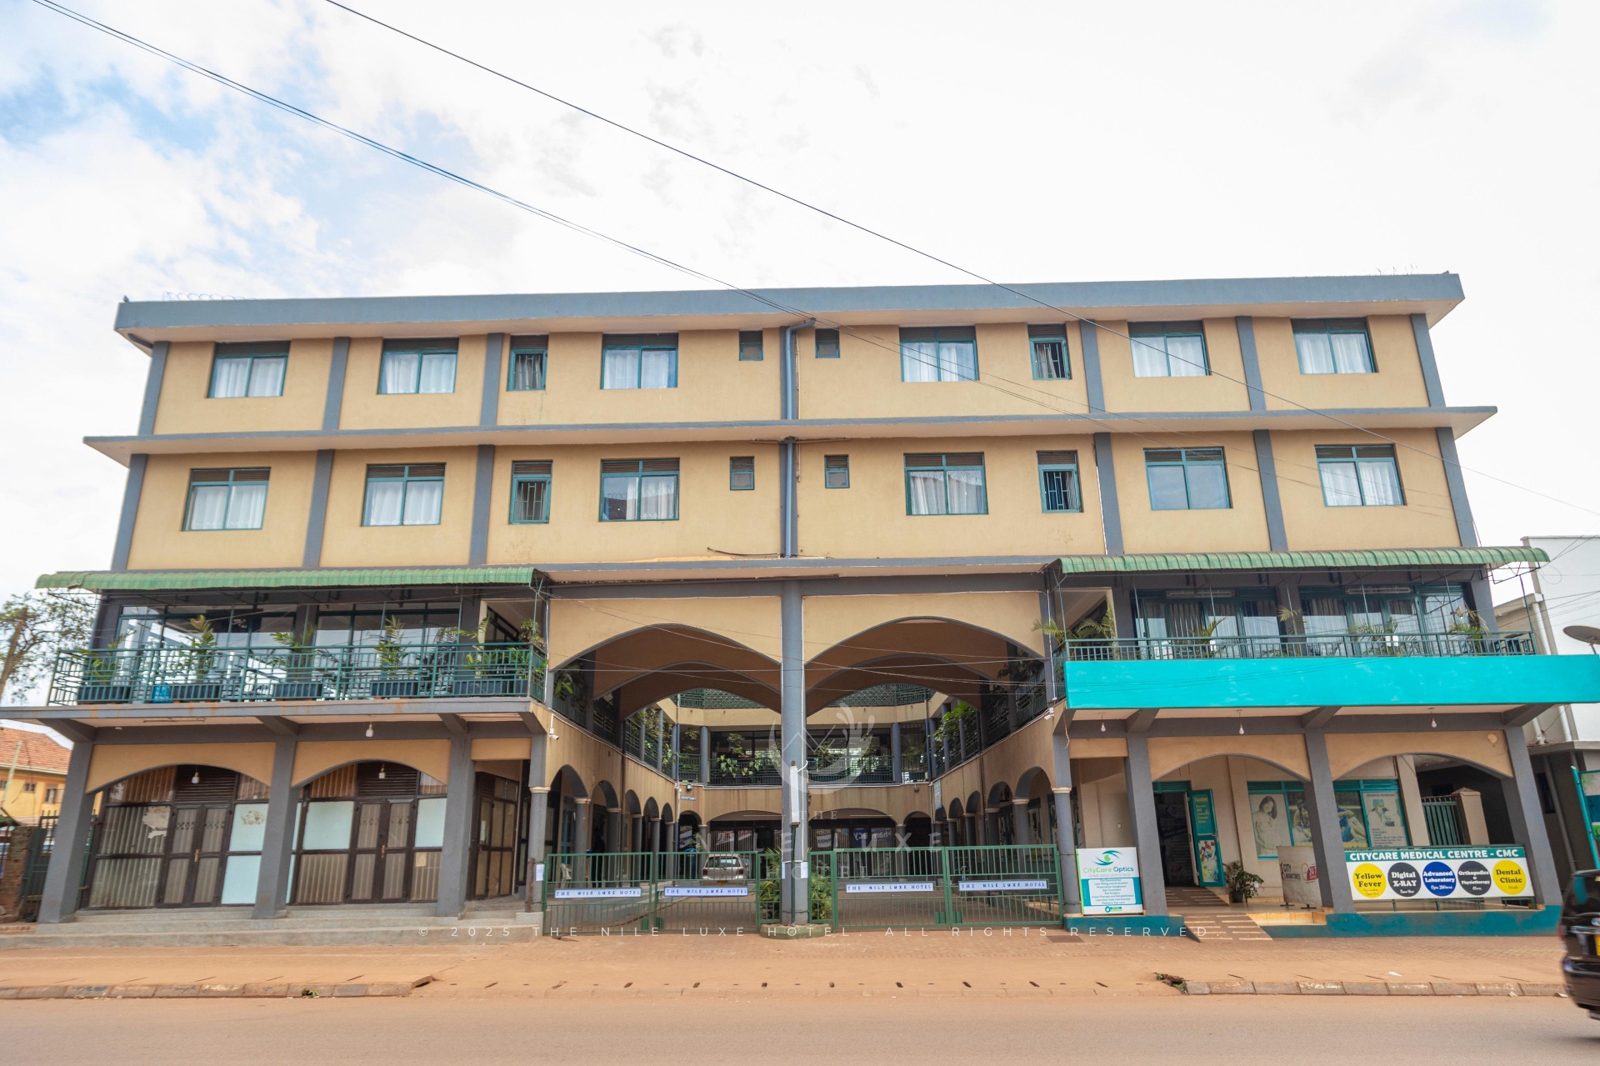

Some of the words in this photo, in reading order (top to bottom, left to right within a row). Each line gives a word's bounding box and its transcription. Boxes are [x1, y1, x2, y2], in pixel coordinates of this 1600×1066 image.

[1350, 851, 1399, 861] CITYCARE
[1400, 850, 1446, 860] MEDICAL
[1447, 849, 1489, 859] CENTRE
[1496, 849, 1519, 858] CMC
[1358, 880, 1382, 888] Fever
